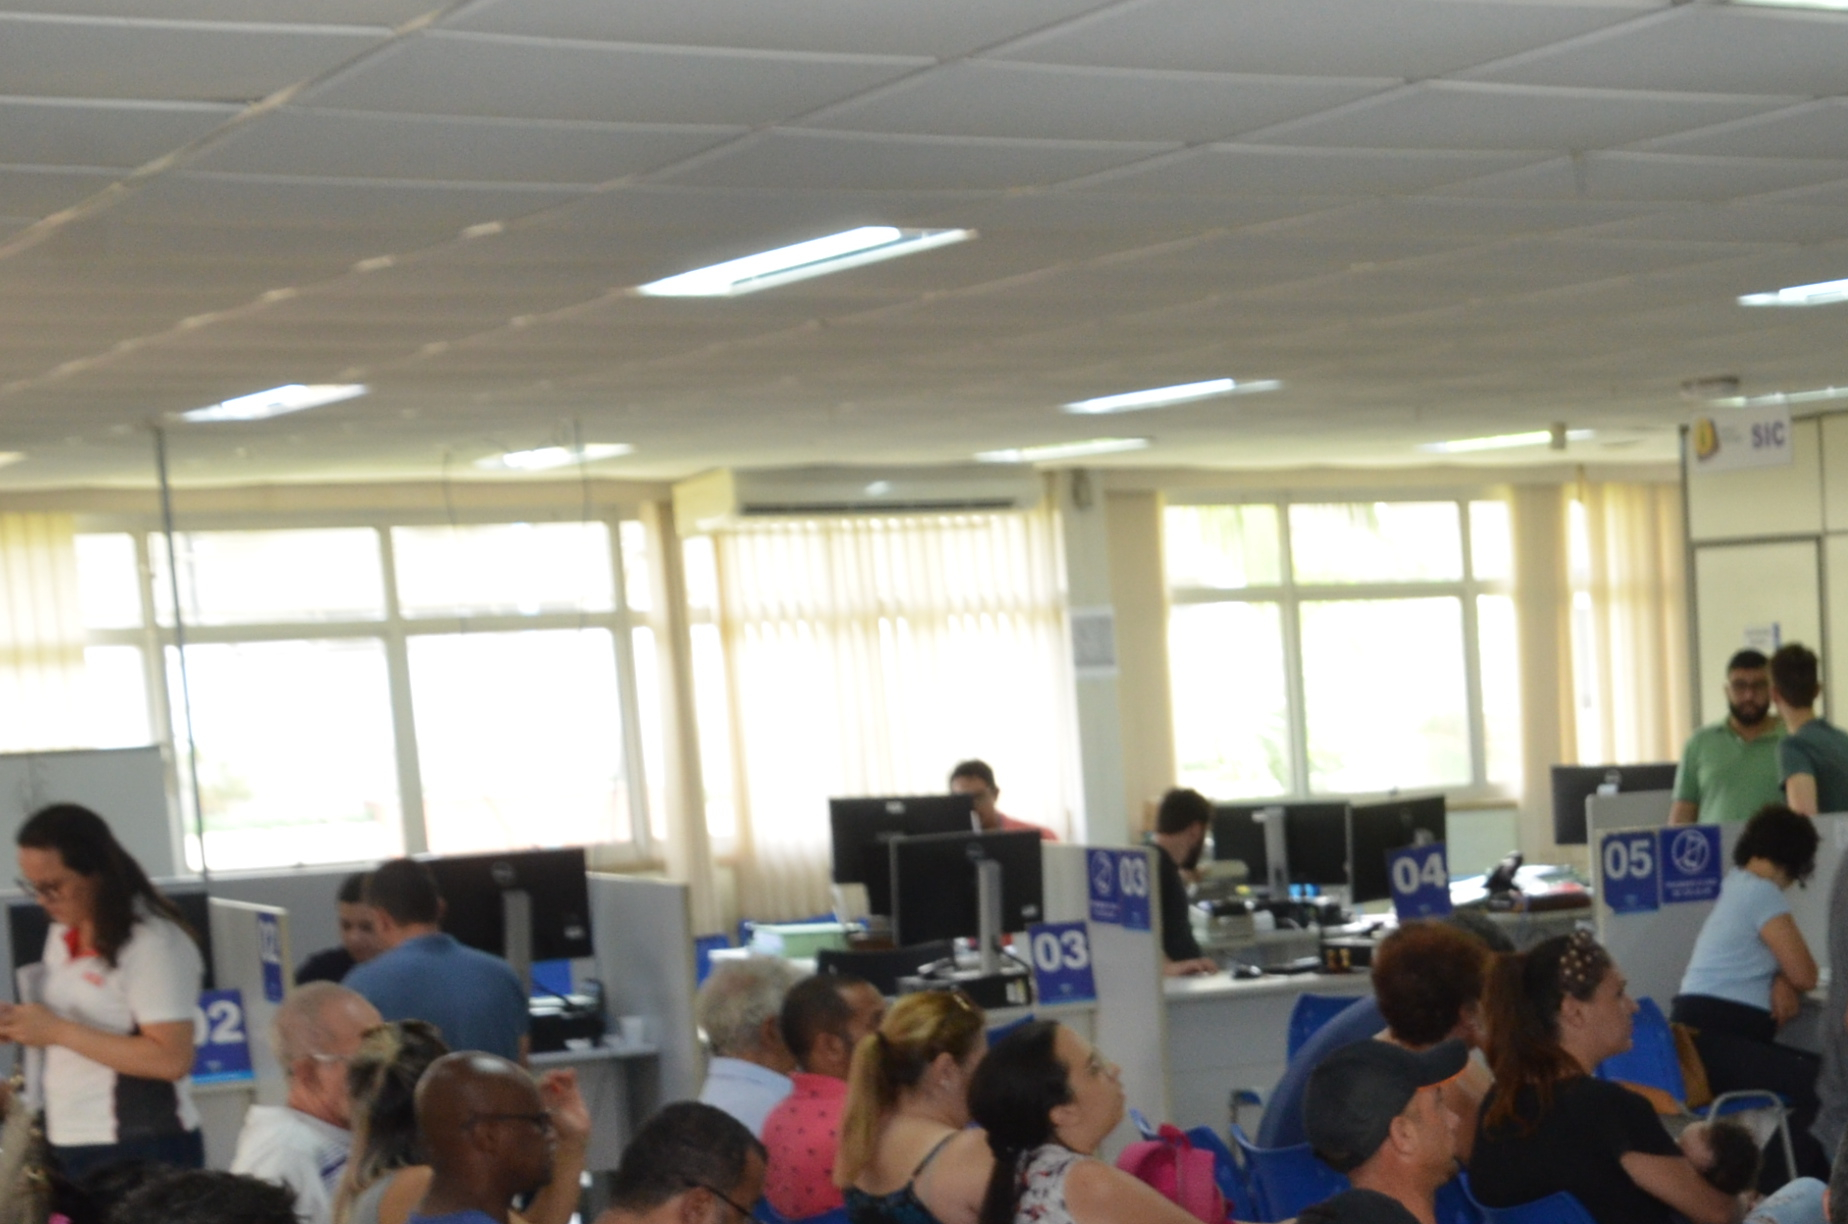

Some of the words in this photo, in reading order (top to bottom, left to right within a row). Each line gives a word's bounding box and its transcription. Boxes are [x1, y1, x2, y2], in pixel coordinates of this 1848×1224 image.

[1751, 420, 1785, 449] SIC
[1118, 855, 1147, 898] 03
[1391, 852, 1448, 896] 04
[1604, 839, 1654, 880] 05
[1033, 929, 1089, 974] 03
